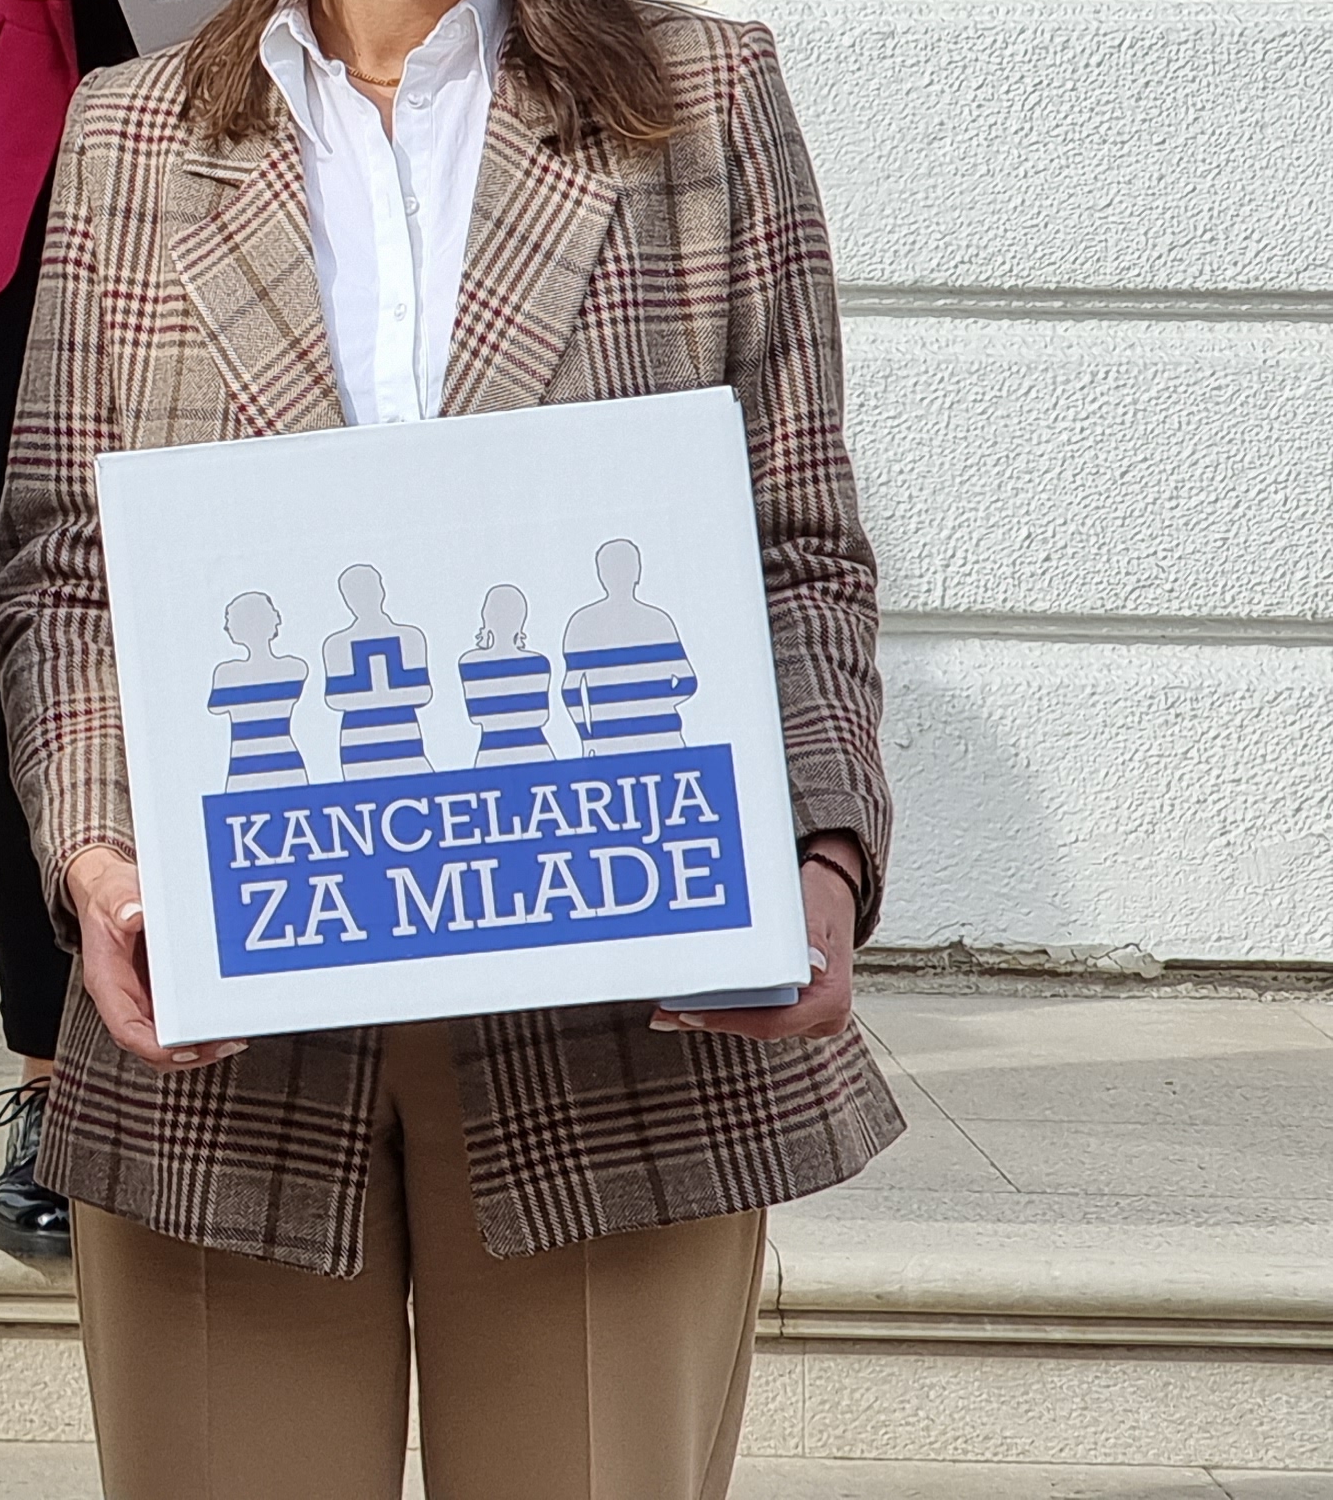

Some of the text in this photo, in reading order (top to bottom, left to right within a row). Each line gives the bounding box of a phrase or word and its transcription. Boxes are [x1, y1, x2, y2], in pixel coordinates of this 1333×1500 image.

[224, 770, 720, 870] KANCELARIJA
[239, 836, 727, 952] ZA MLADE
